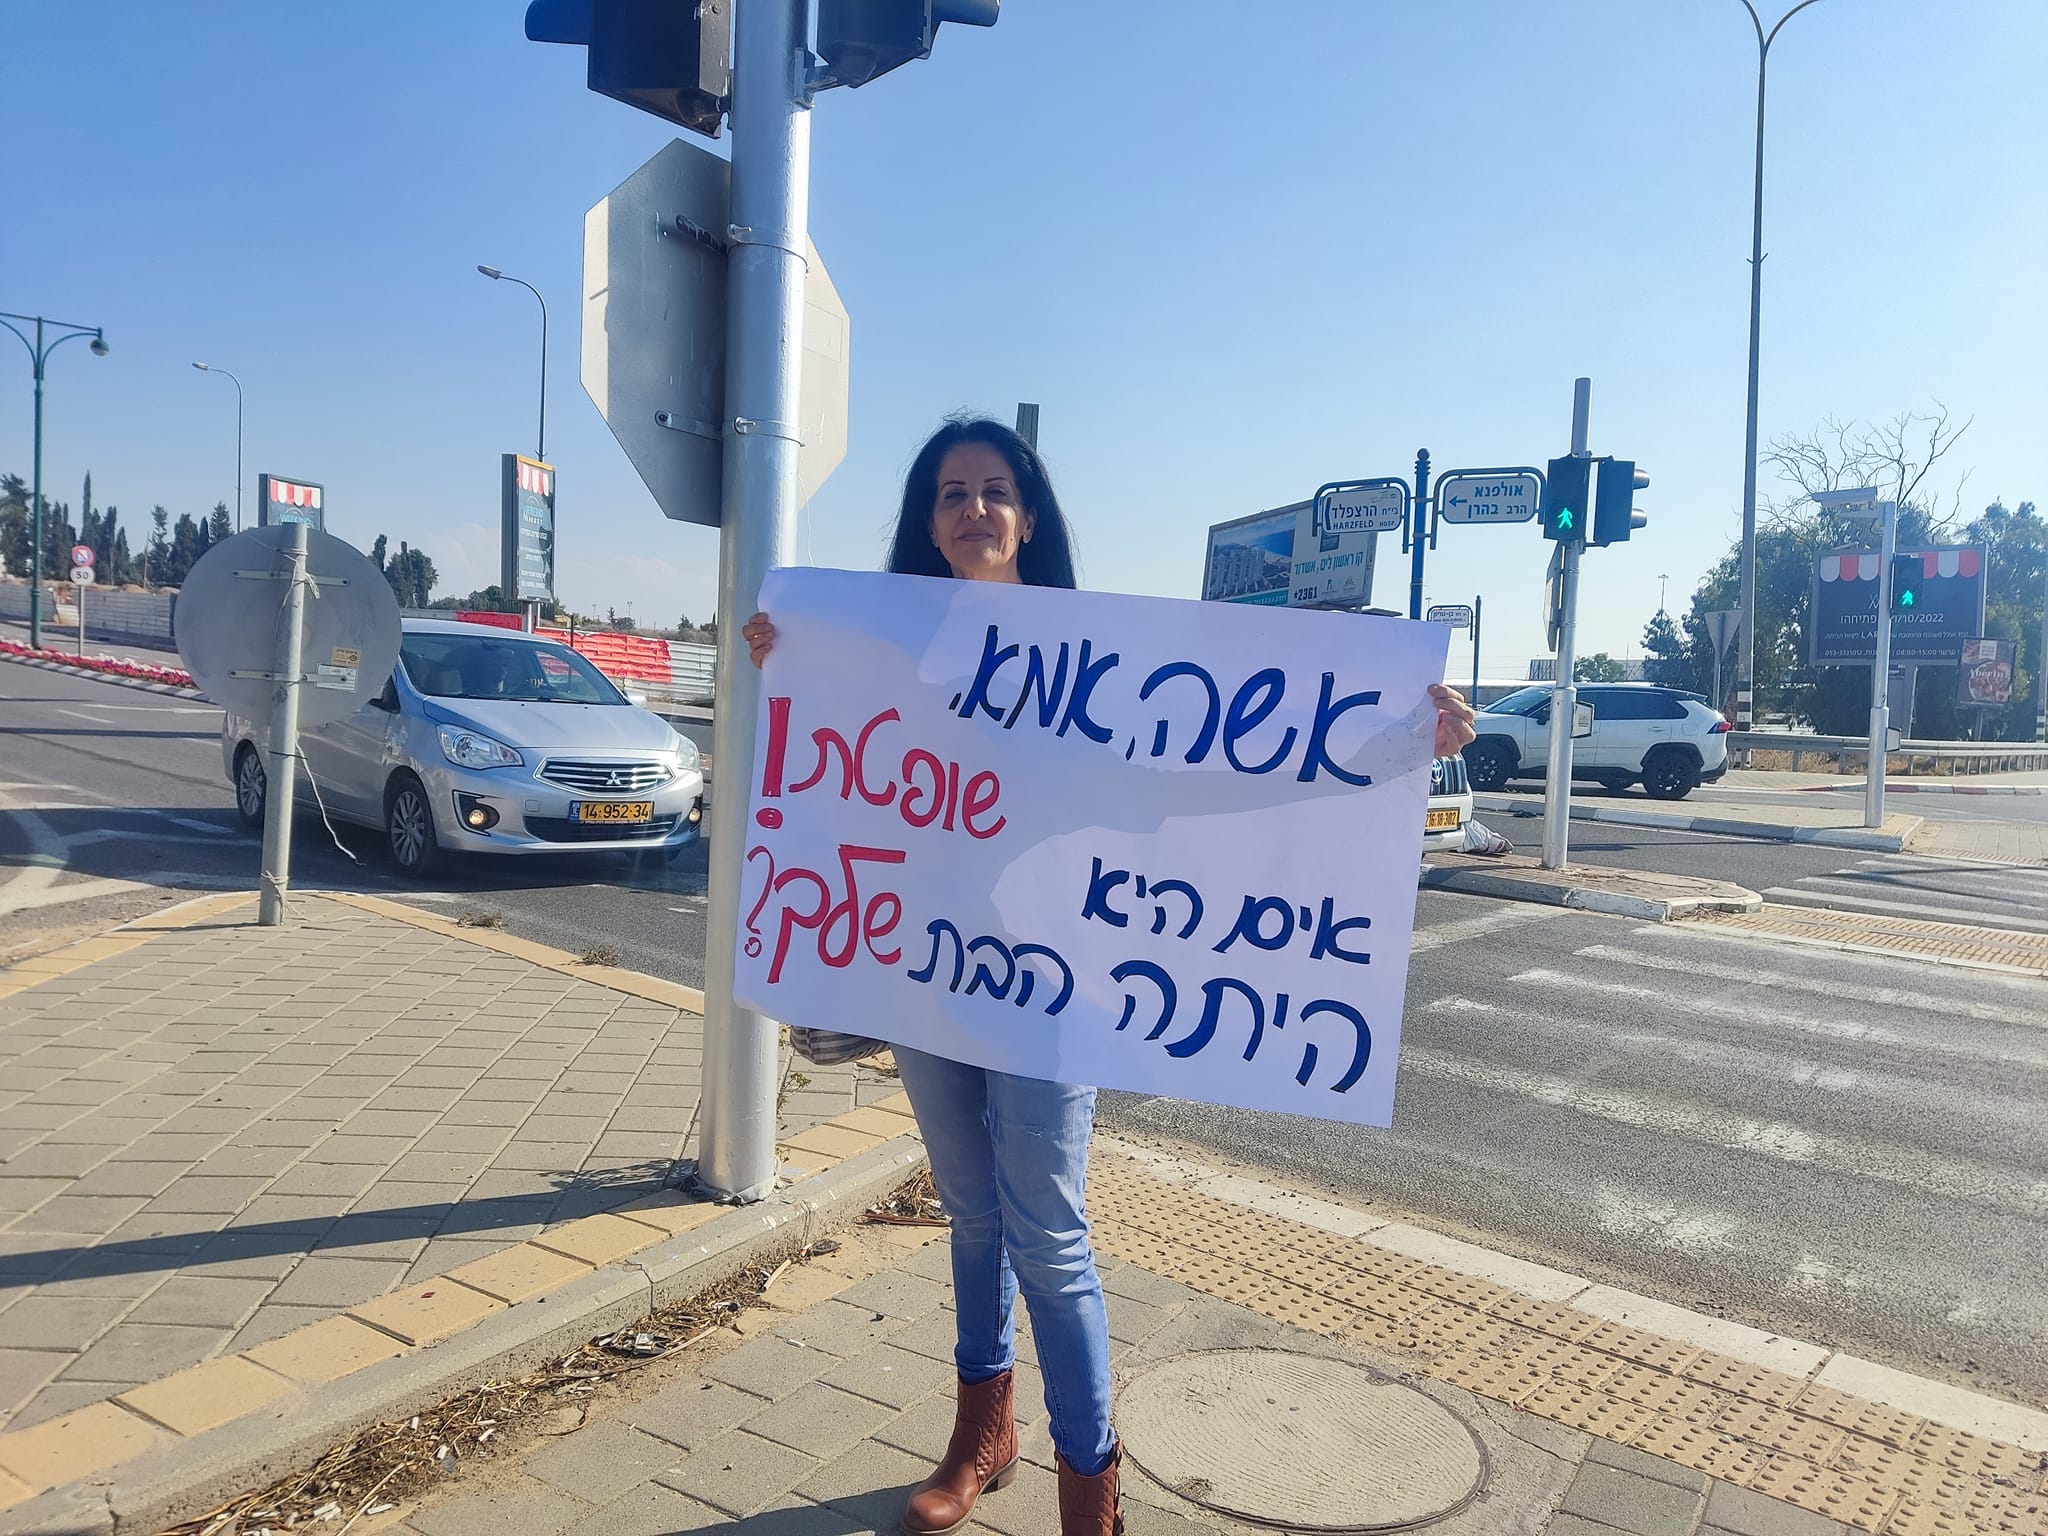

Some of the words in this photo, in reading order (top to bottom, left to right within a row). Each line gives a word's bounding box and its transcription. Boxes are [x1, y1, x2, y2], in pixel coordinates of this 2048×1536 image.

[1332, 503, 1377, 519] הרצפלד
[1474, 481, 1524, 498] אולפנא
[1505, 504, 1527, 514] הרב
[1333, 520, 1374, 530] HARZFELD
[75, 571, 89, 579] 50
[756, 697, 1006, 839] שופטת!
[744, 843, 907, 985] שלך?
[1081, 857, 1204, 940] היא
[908, 918, 1075, 1017] הבת
[1110, 960, 1373, 1093] היתה
